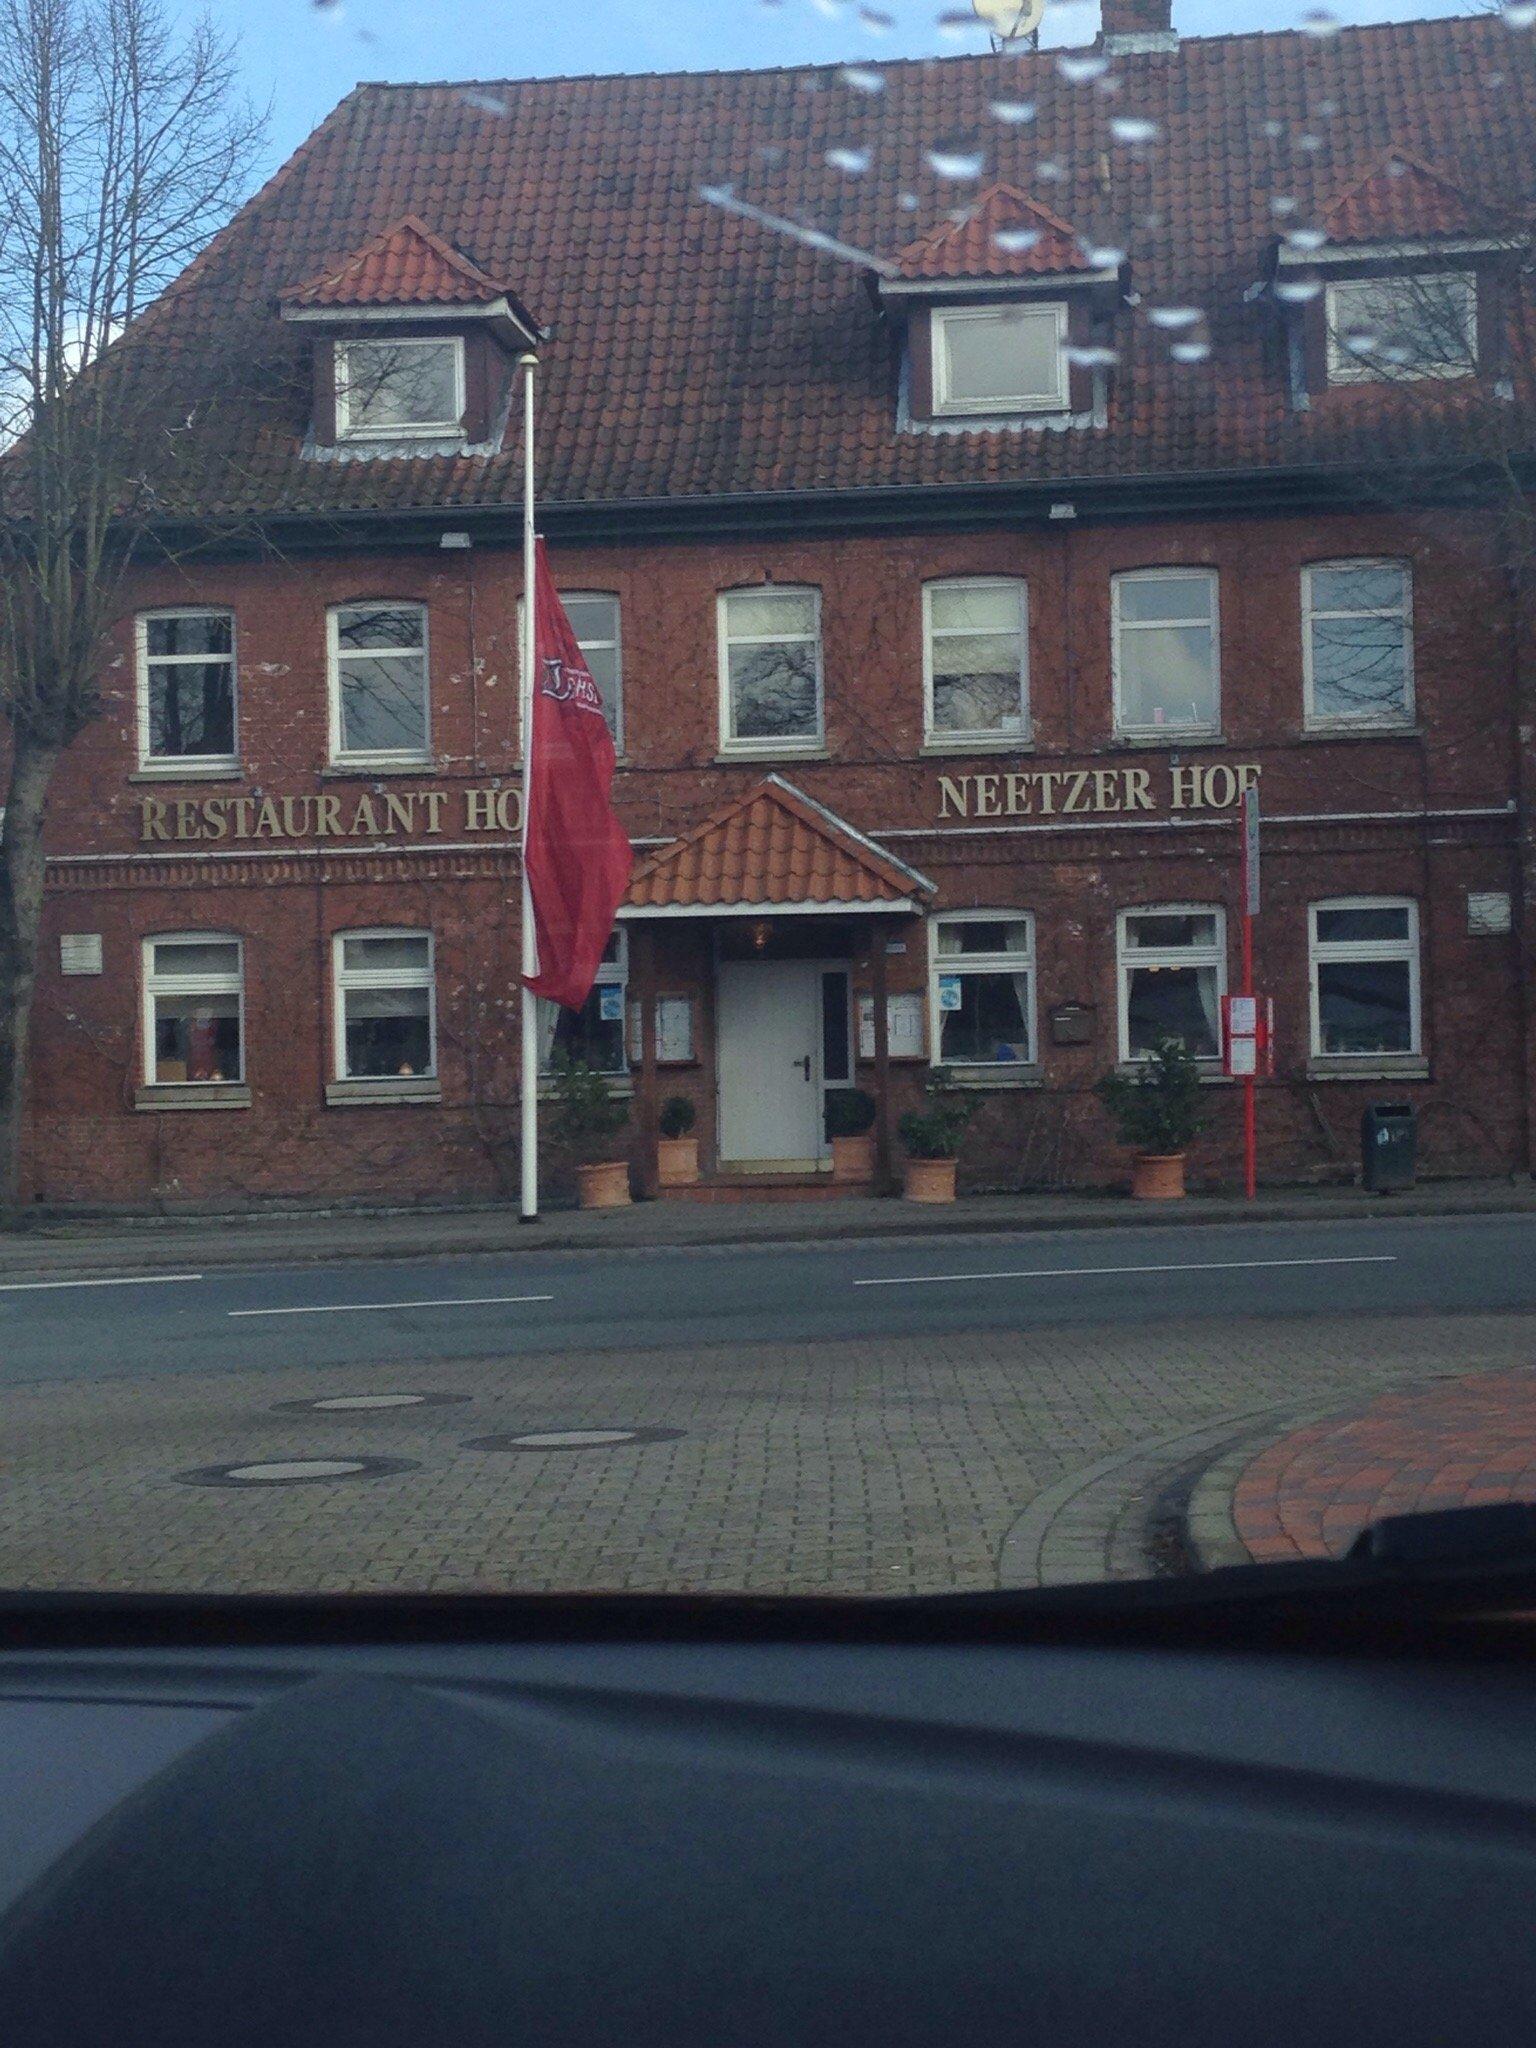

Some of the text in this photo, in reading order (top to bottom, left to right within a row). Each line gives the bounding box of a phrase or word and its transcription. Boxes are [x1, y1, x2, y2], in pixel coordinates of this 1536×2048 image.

[140, 791, 448, 842] RESTAURANT
[937, 764, 1262, 818] NEETZER HOF
